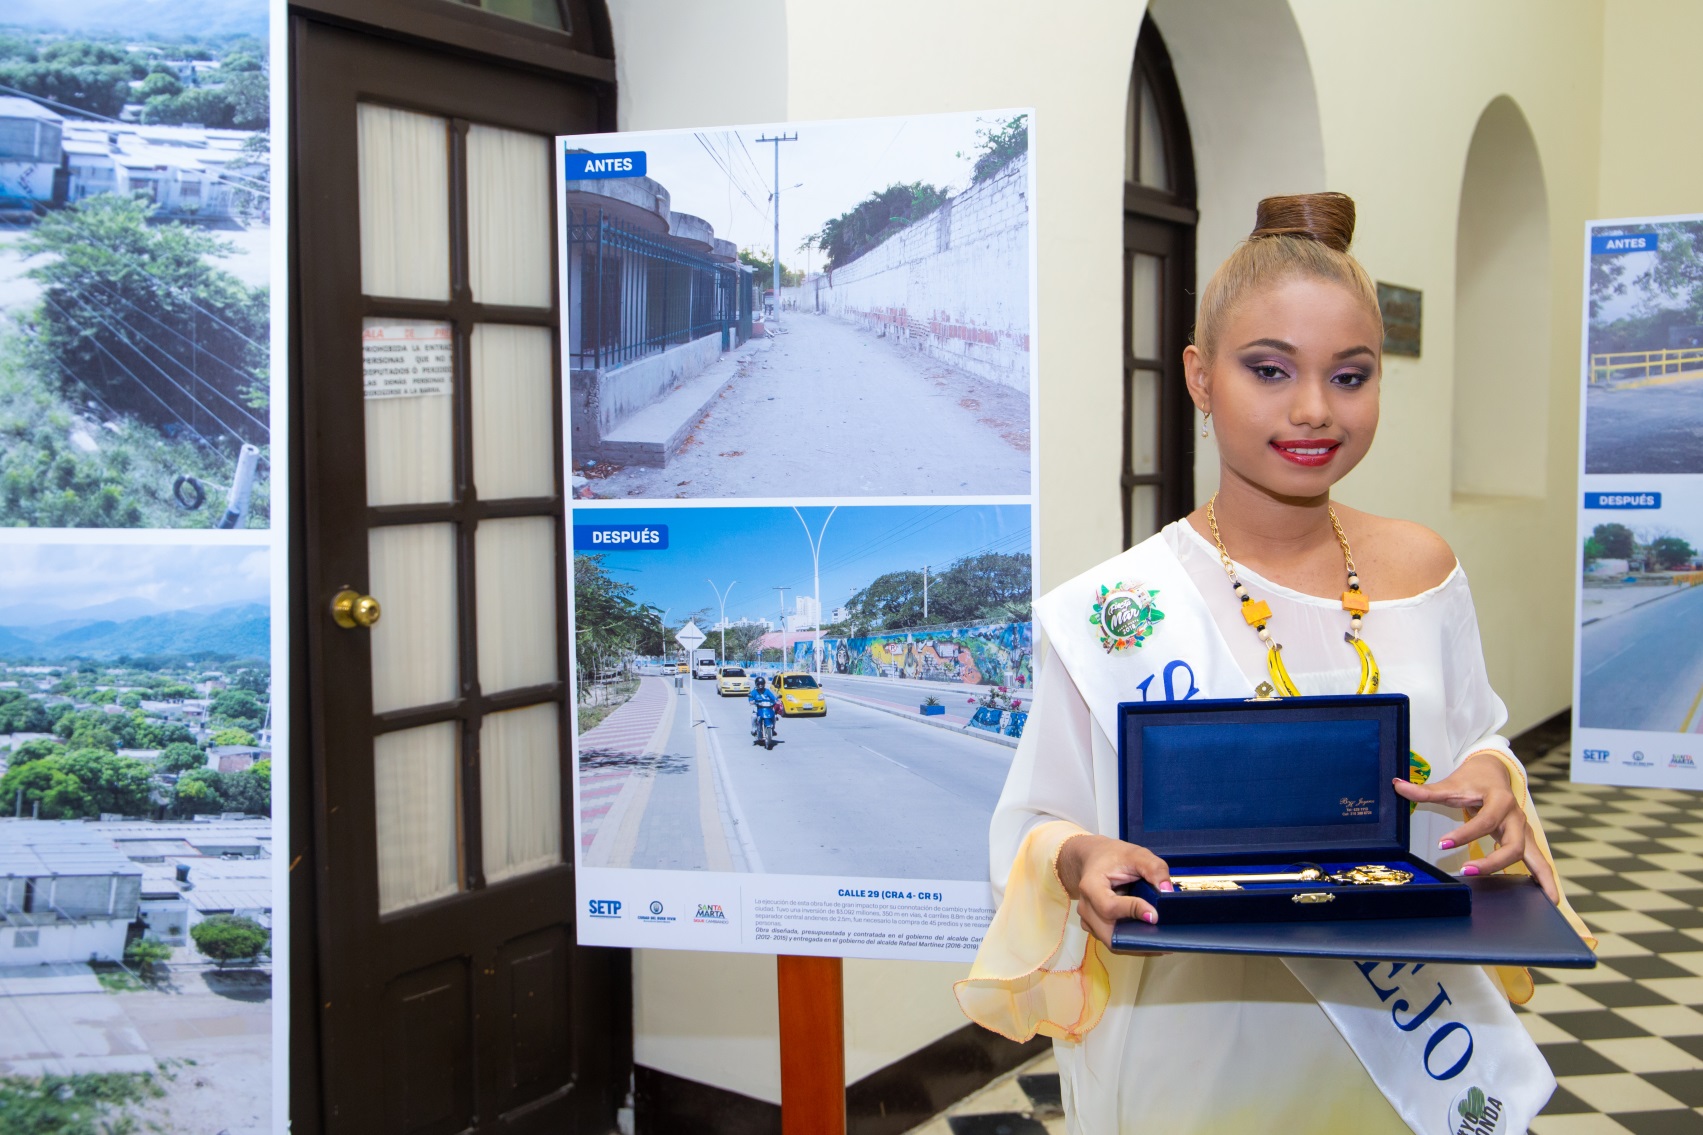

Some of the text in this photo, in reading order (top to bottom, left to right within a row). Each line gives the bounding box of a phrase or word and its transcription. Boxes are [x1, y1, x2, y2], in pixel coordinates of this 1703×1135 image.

[584, 156, 633, 173] ANTES
[1606, 238, 1646, 250] ANTES
[415, 356, 430, 364] QUE
[1599, 494, 1654, 506] DESPUÉS
[592, 528, 660, 545] DESPUÉS
[1110, 608, 1140, 630] Mar
[1583, 749, 1610, 760] SETP
[838, 889, 866, 898] CALLE
[868, 890, 880, 898] 29
[882, 890, 904, 900] (CRA
[918, 892, 930, 900] CR
[933, 892, 942, 902] 5)
[589, 900, 622, 915] SETP
[698, 904, 722, 912] SANTA
[855, 902, 878, 910] impacto
[696, 910, 726, 919] MARTA
